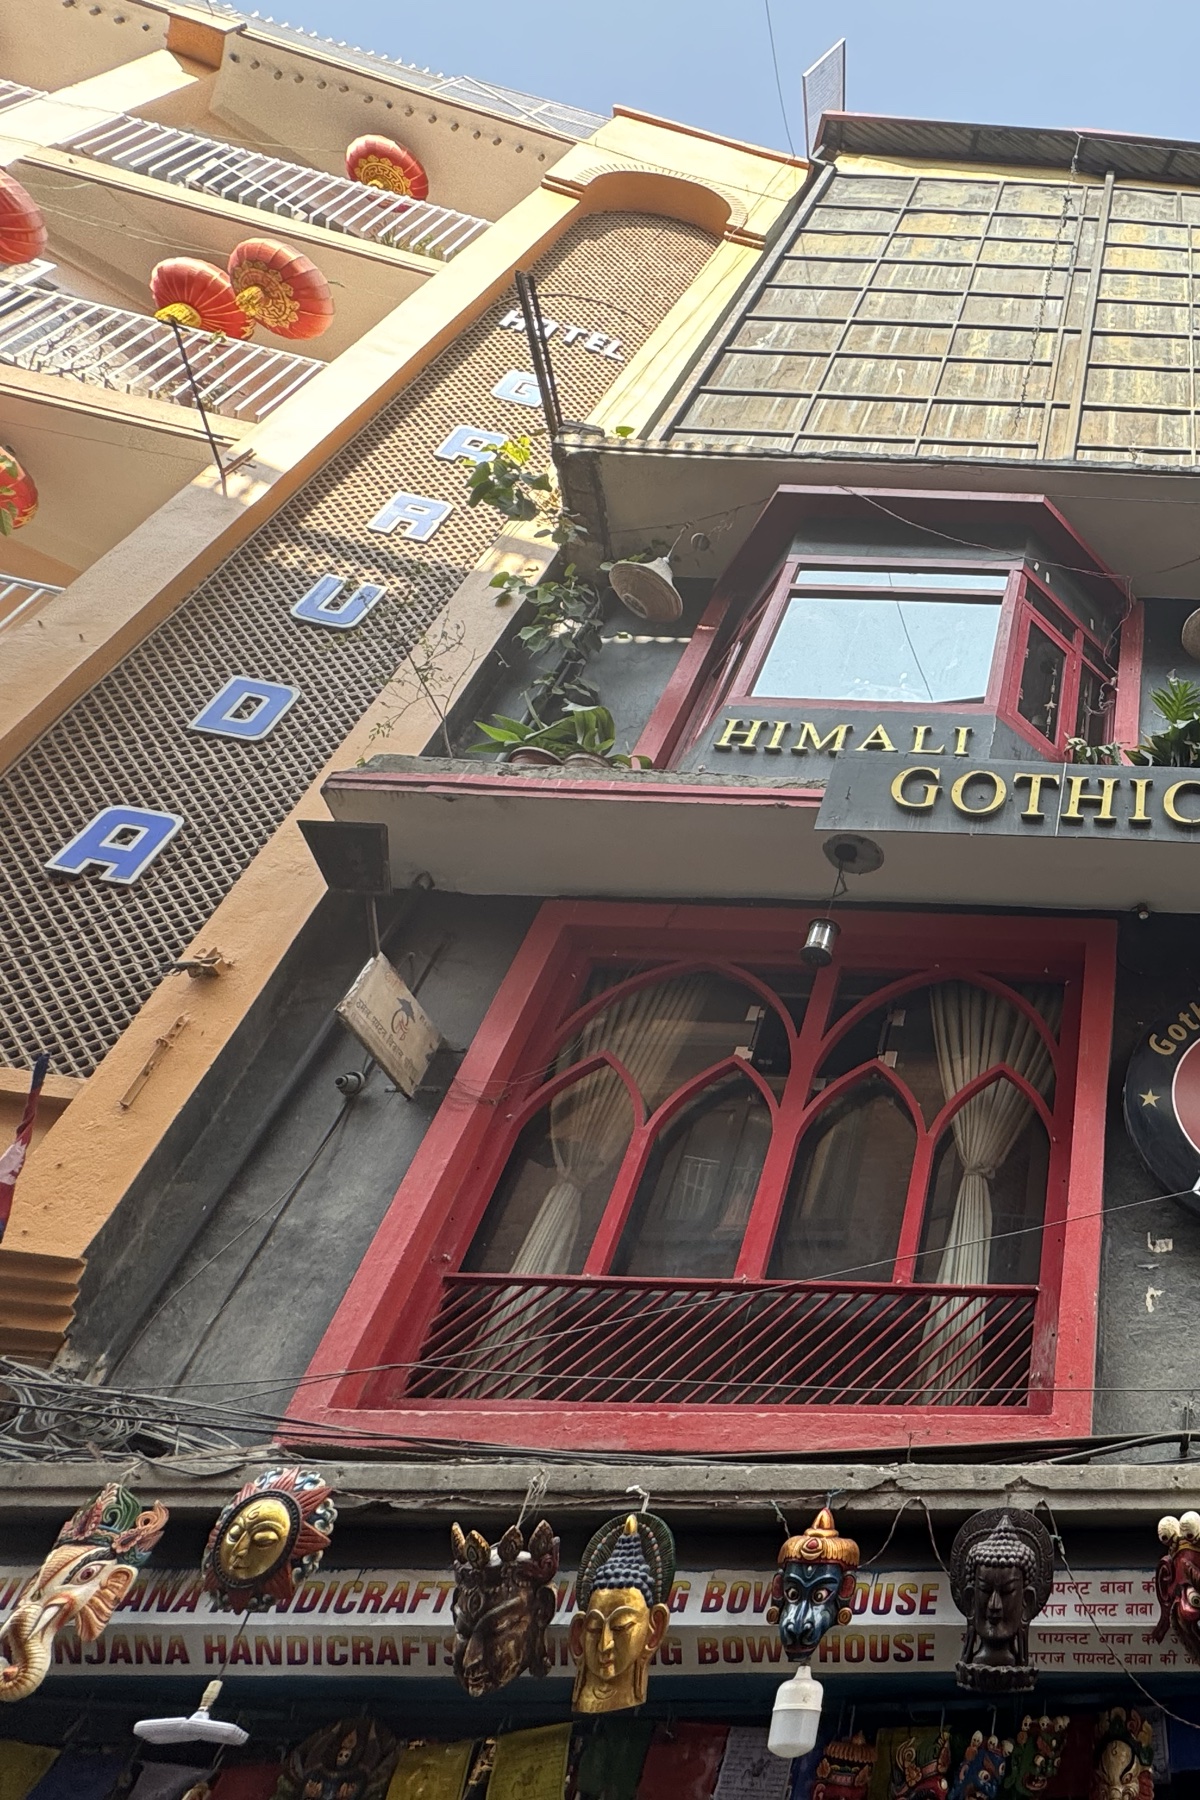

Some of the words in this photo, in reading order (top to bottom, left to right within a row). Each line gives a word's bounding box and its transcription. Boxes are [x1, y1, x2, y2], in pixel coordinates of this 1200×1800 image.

[45, 369, 544, 886] GARUDA
[713, 719, 973, 756] HIMALI
[701, 1580, 774, 1614] BOW
[851, 1581, 940, 1616] OUSE
[1100, 1581, 1134, 1595] बाबा
[1074, 1603, 1118, 1617] पायलट
[1125, 1603, 1154, 1617] बाबा
[697, 1636, 784, 1665] BOW
[819, 1633, 936, 1665] HOUSE
[1037, 1632, 1090, 1645] पायलट
[1073, 1652, 1116, 1666] पायलट
[1124, 1653, 1153, 1666] बाबा
